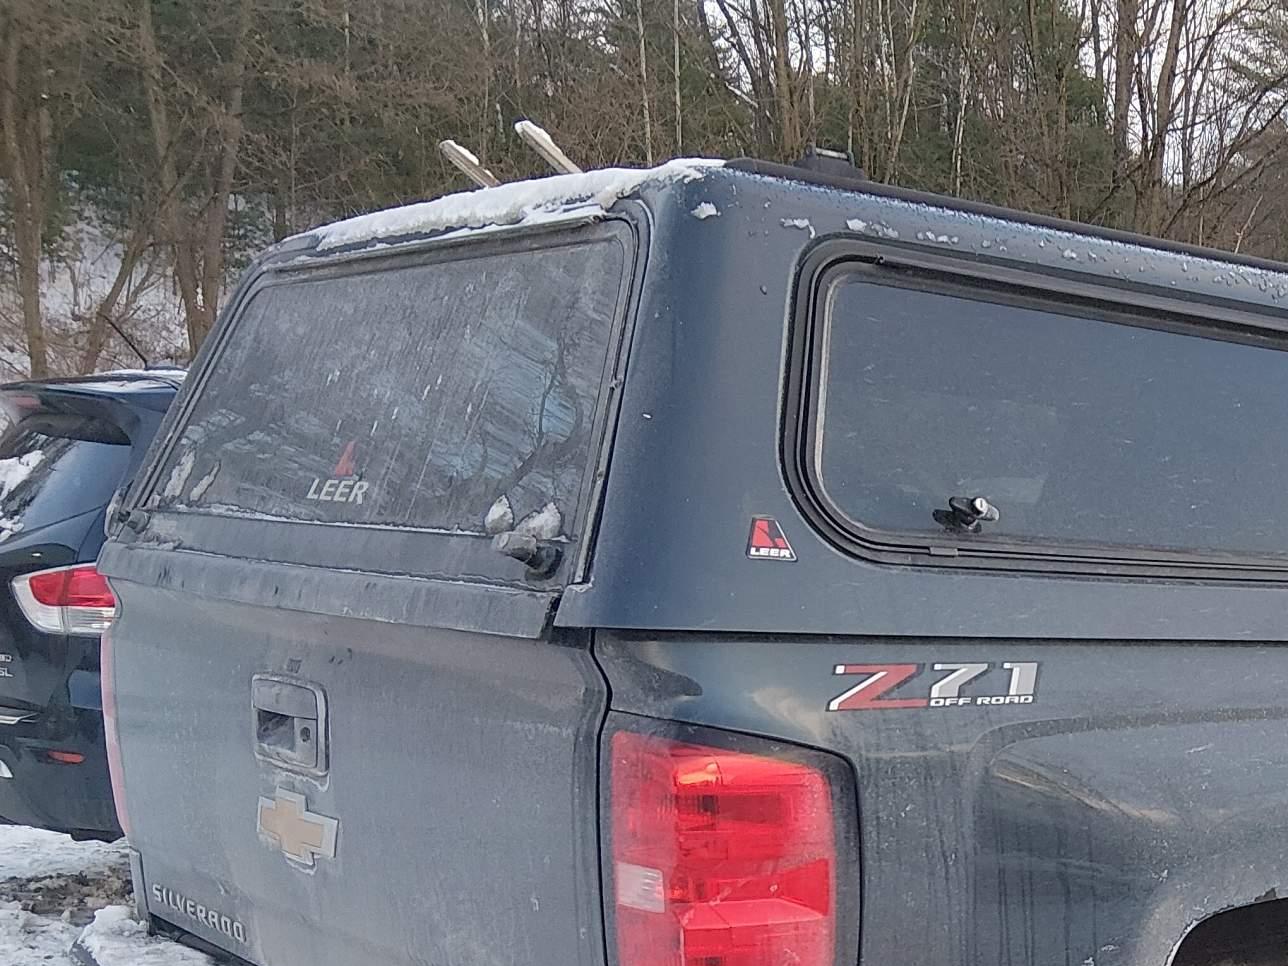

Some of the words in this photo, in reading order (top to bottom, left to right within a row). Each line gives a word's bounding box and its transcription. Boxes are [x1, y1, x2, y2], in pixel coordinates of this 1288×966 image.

[306, 478, 369, 504] LEER
[750, 547, 791, 558] LEER
[827, 662, 1039, 712] Z71
[929, 697, 972, 707] OFF
[976, 695, 1034, 705] ROAD
[152, 883, 246, 943] SILVERADO
